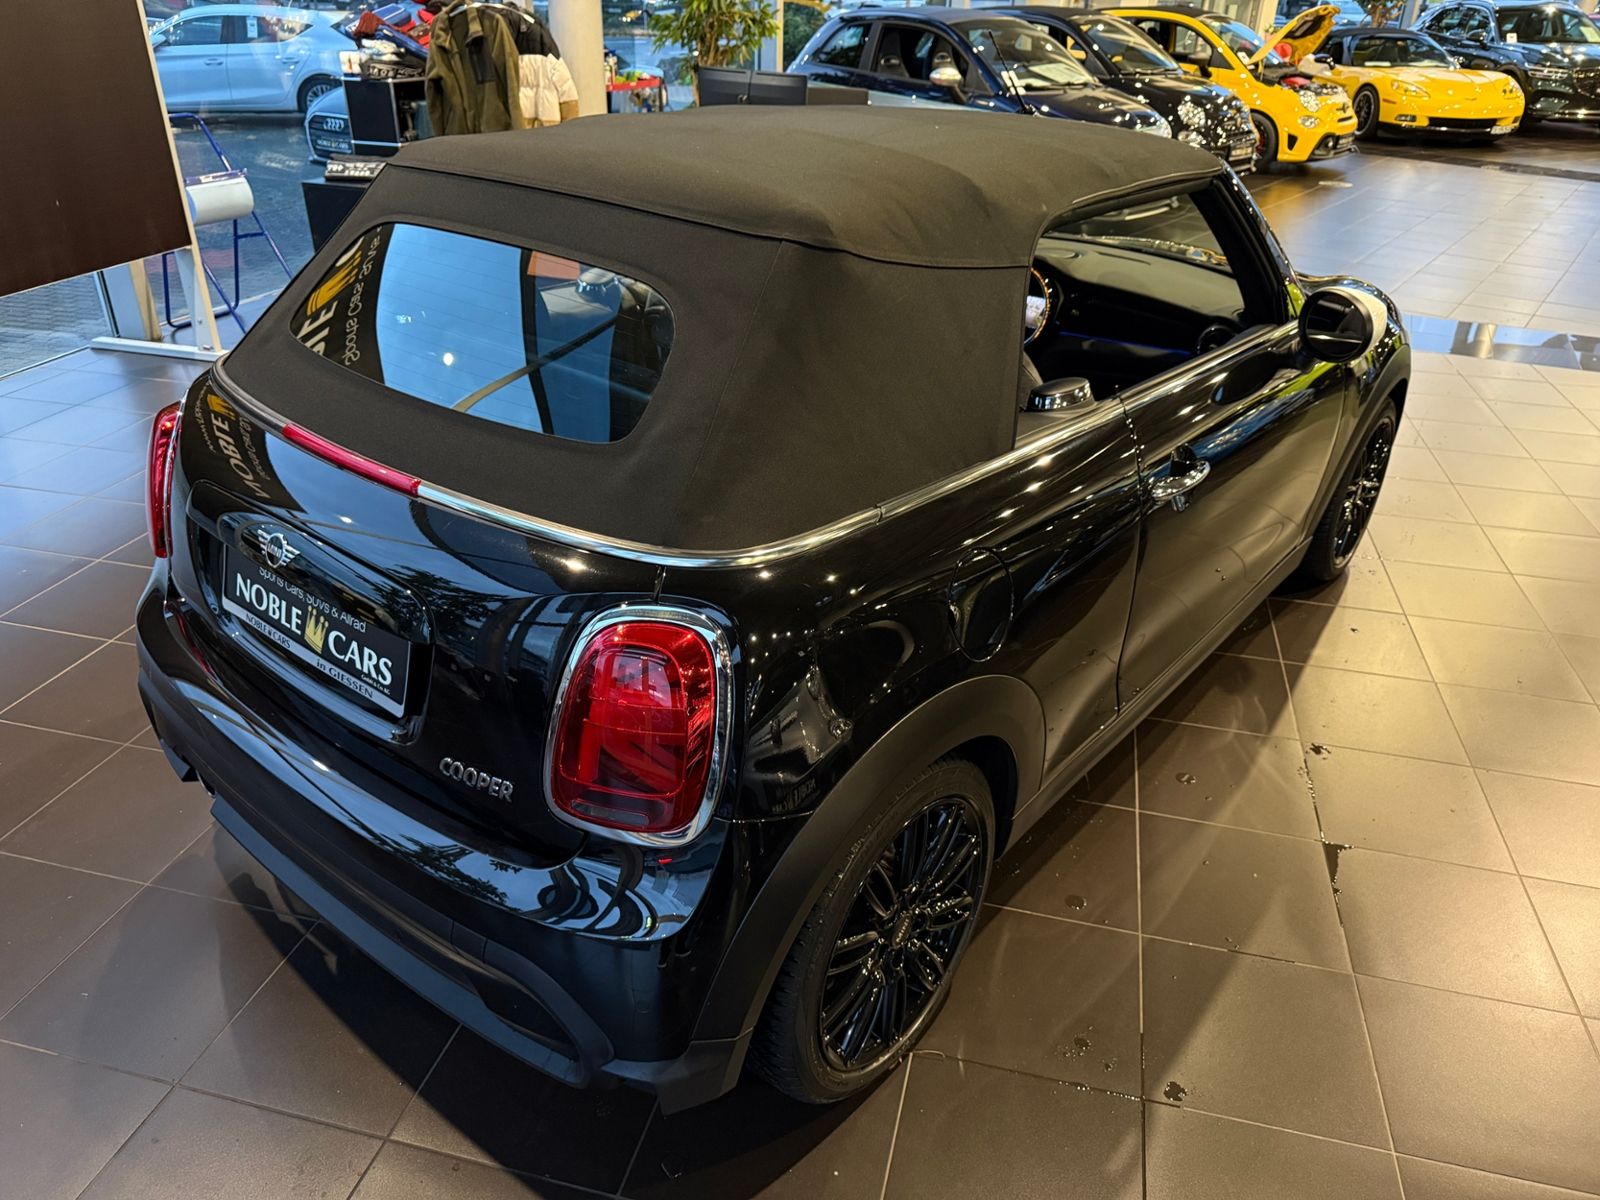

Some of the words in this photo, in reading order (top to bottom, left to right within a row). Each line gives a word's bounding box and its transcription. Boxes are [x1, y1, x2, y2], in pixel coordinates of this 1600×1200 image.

[236, 572, 302, 636] NOBLE
[328, 630, 393, 686] CARS
[331, 606, 339, 618] &
[340, 611, 367, 633] Allrad
[272, 632, 291, 648] CARS
[317, 659, 326, 671] in
[329, 667, 374, 698] GIESSEN
[440, 757, 513, 803] COOPER
